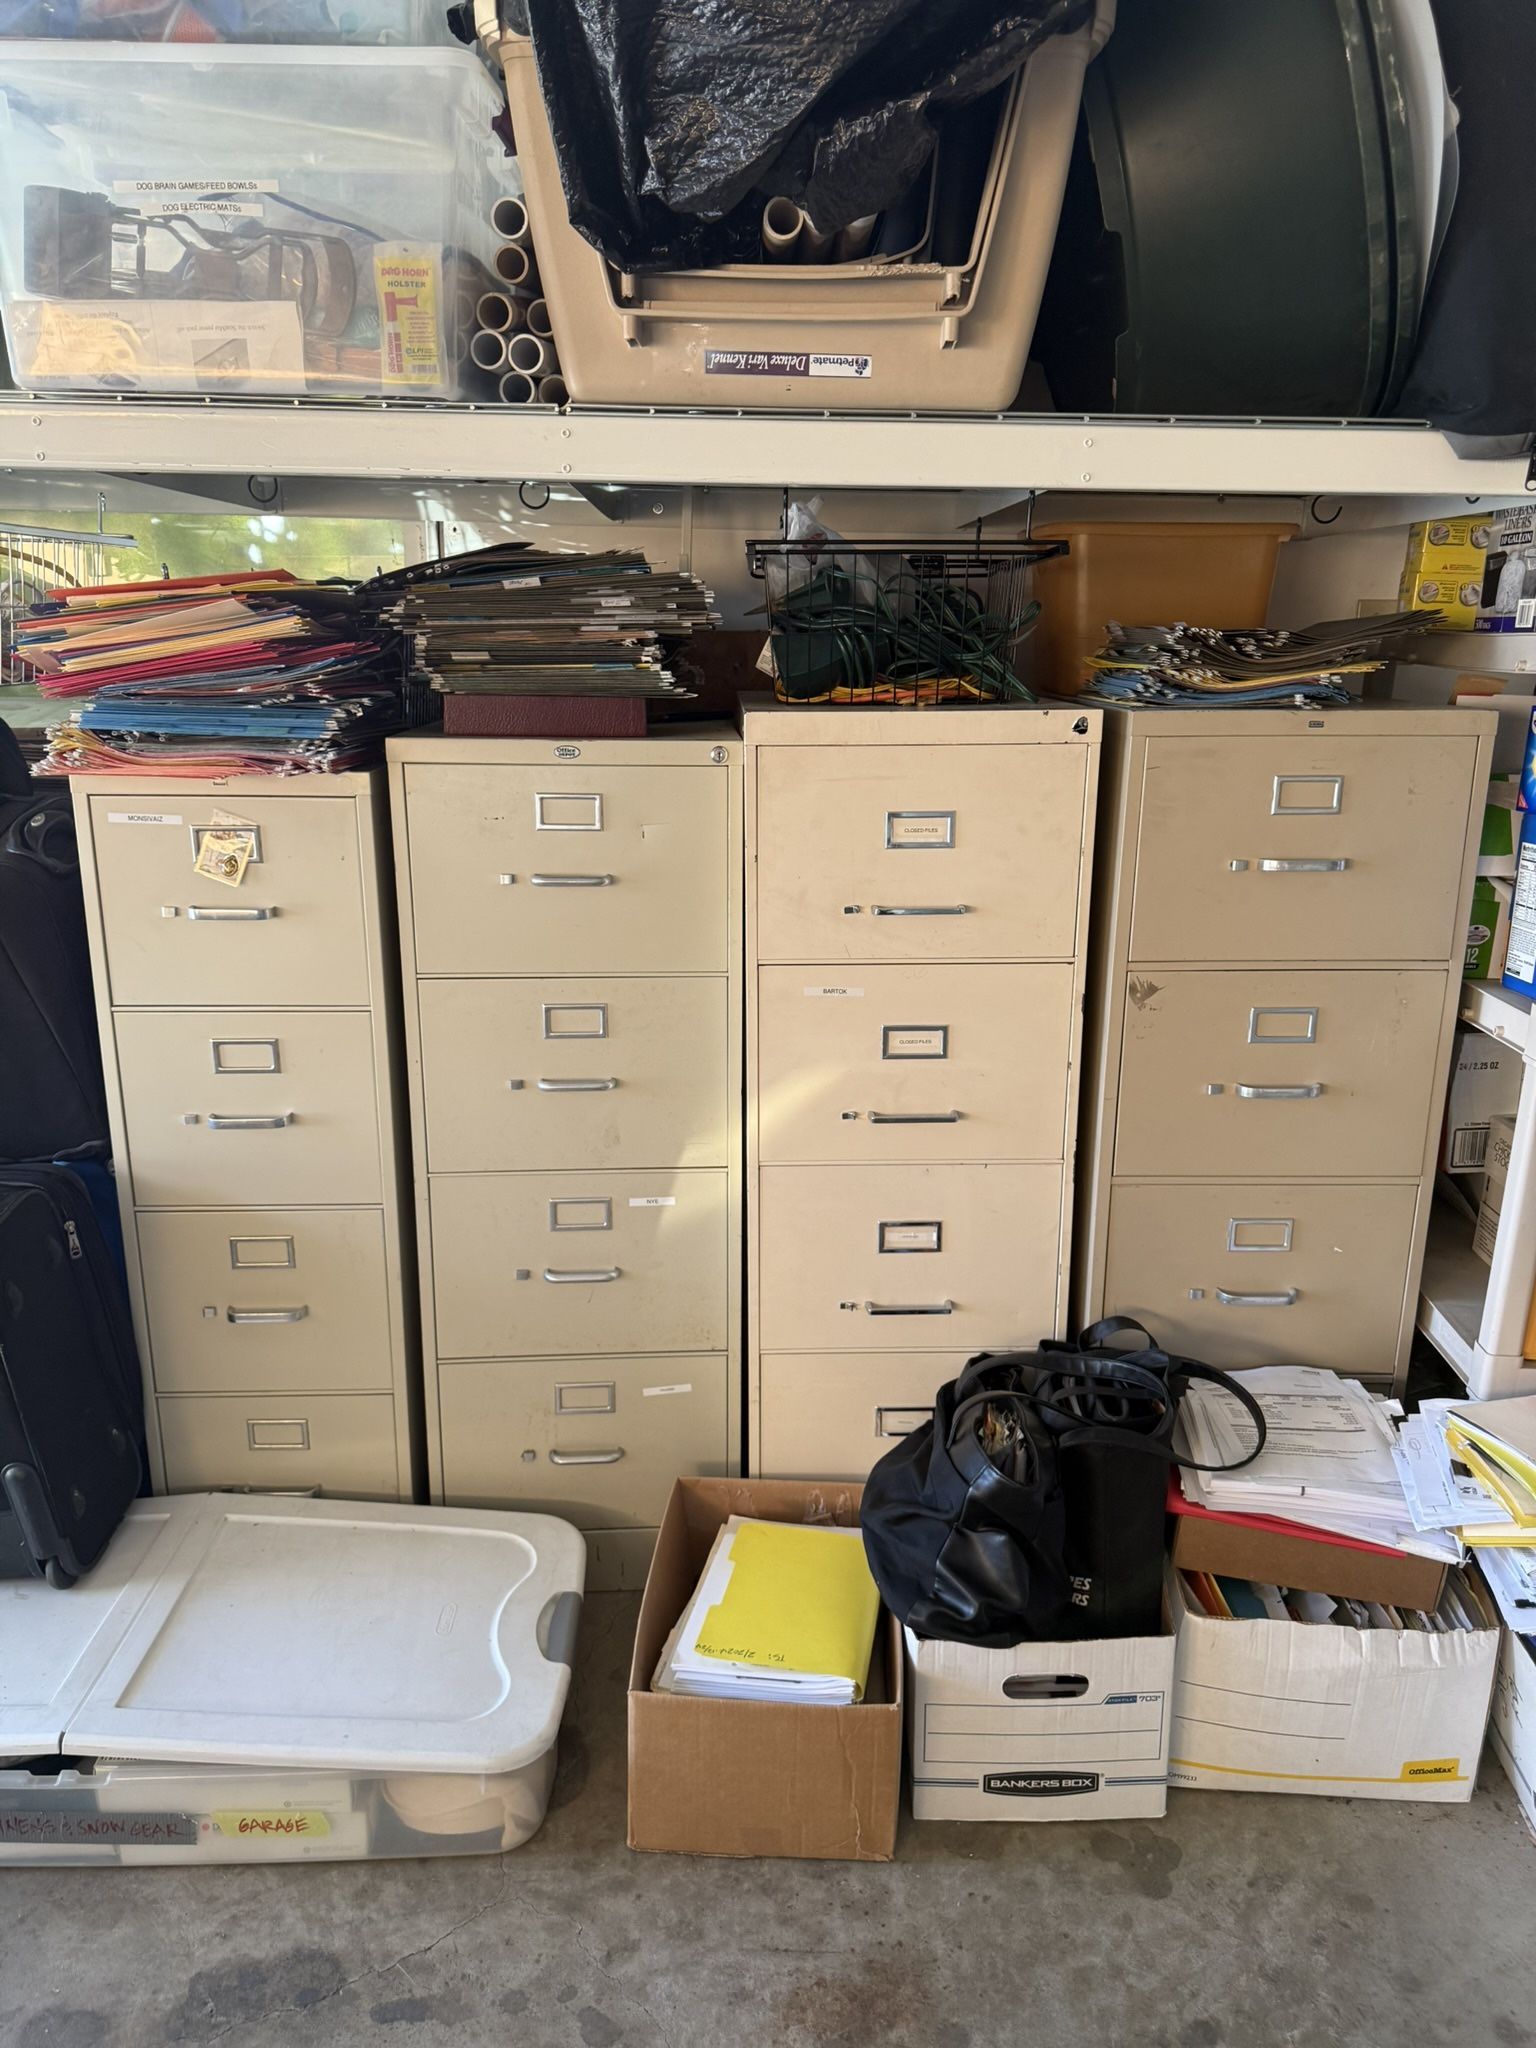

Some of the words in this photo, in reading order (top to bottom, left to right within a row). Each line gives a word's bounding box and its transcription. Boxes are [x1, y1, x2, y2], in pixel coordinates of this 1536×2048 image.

[136, 182, 153, 190] DOG
[154, 182, 177, 190] BRAIN
[178, 181, 226, 190] GAMES/FEED
[227, 181, 258, 190] BOWLSs
[162, 203, 179, 212] DOG
[180, 203, 216, 212] ELECTRIC
[217, 204, 242, 213] MATSs
[381, 267, 401, 277] DOG
[402, 267, 429, 277] HORN
[387, 280, 426, 288] HOLSTER
[709, 353, 748, 369] Kennel
[749, 354, 769, 370] Vari
[770, 355, 807, 371] Deluxe
[812, 356, 854, 367] Petmate
[1508, 532, 1532, 544] GALLON
[1473, 1062, 1488, 1070] 2.25
[1489, 1061, 1499, 1070] OZ
[990, 1779, 1059, 1788] BANKERS
[1062, 1779, 1093, 1787] BOX
[78, 1818, 126, 1836] SNOW
[129, 1823, 188, 1839] GEAR
[238, 1817, 310, 1834] GARAGE
